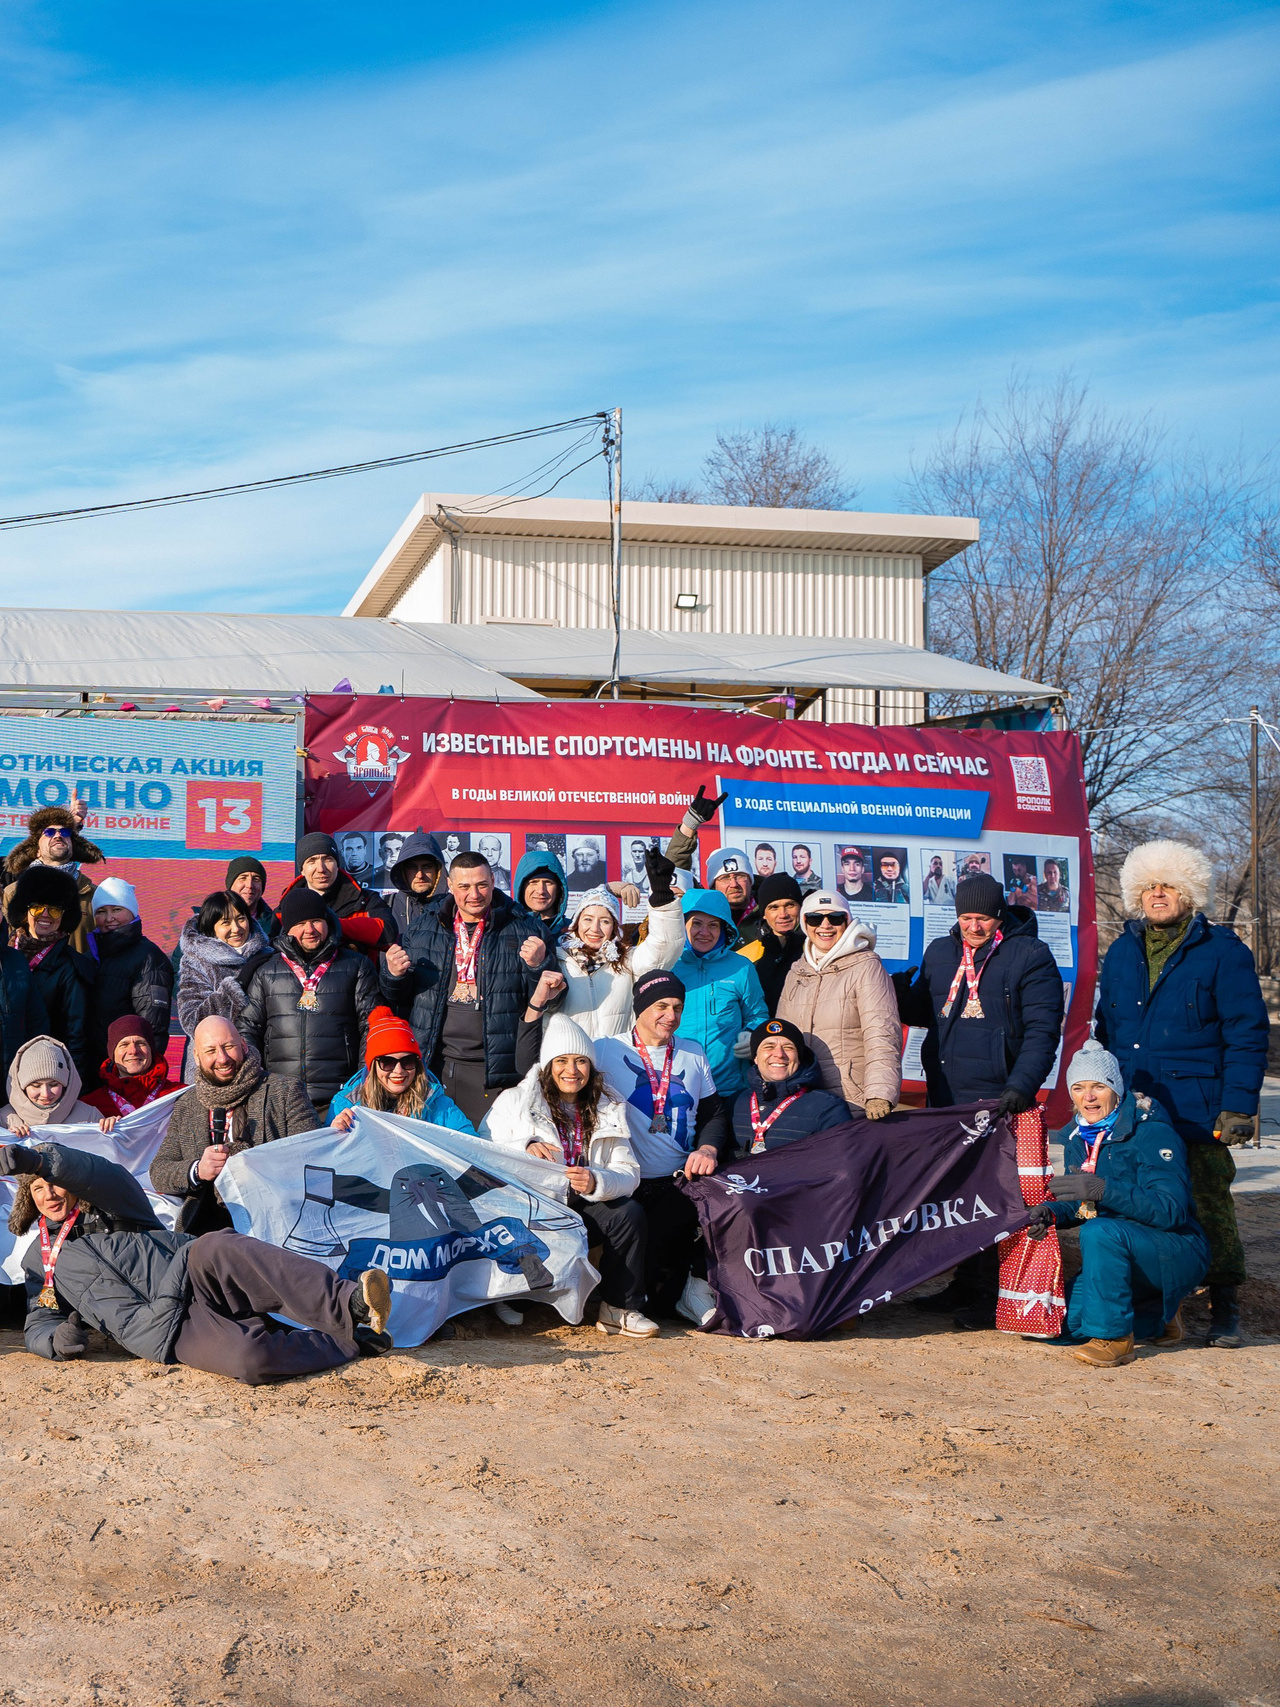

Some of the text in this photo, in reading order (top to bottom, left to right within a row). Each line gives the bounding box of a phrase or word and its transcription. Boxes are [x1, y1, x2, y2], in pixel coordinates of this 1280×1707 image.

[422, 732, 550, 756] ИЗВЕСТНЫЕ
[555, 735, 701, 760] СПОРТСМЕНЫ
[707, 742, 733, 764] НА
[735, 745, 823, 770] ФРОНТЕ.
[825, 751, 890, 773] ТОГДА
[896, 753, 909, 772] И
[914, 752, 990, 777] СЕЙЧАС
[170, 758, 264, 777] АКЦИЯ
[452, 788, 459, 800] В
[462, 789, 496, 802] ГОДЫ
[500, 788, 555, 803] ВЕЛИКОЙ
[558, 789, 656, 806] ОТЕЧЕСТВЕННОЙ
[1016, 796, 1051, 805] ЯРОПОЛК
[196, 797, 253, 834] 13
[735, 798, 972, 820] В ХОДЕ СПЕЦИАЛЬНОЙ ВОЕННОЙ ОПЕРАЦИИ
[105, 814, 171, 830] ВОЙНЕ
[366, 1244, 431, 1274] ДОМ
